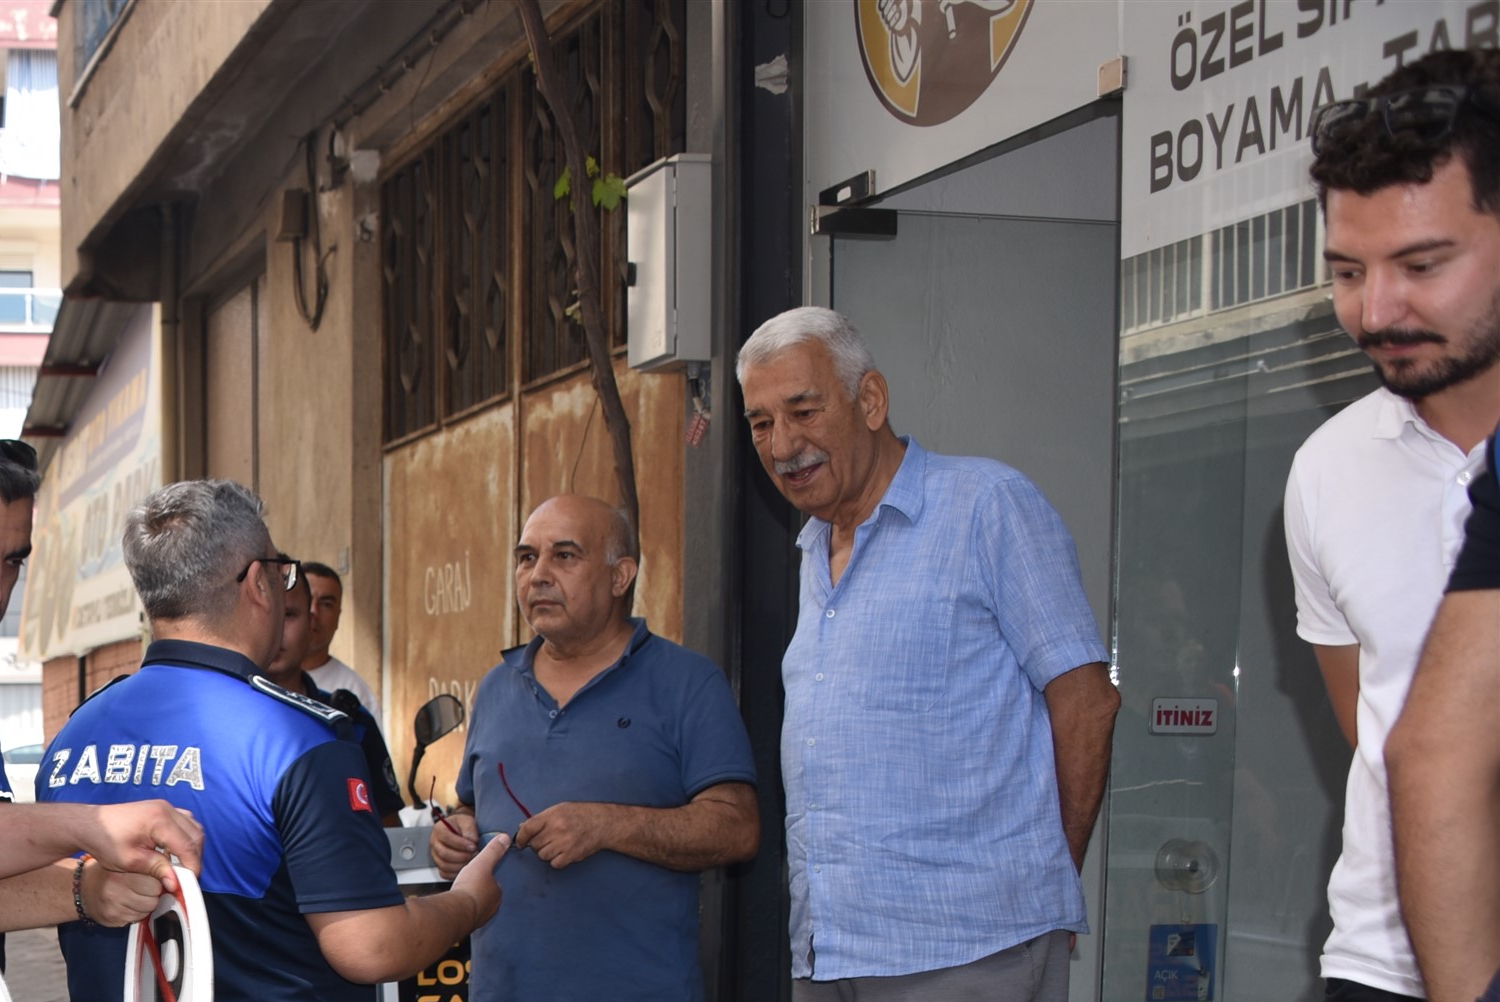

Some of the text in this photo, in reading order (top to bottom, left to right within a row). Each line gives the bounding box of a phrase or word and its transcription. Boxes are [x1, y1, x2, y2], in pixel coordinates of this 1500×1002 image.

[1171, 0, 1283, 91] ÖZEL
[424, 551, 471, 615] GARAJ
[1156, 705, 1213, 726] İTİNİZ
[49, 744, 204, 790] ZABITA
[1154, 970, 1179, 983] AÇIK
